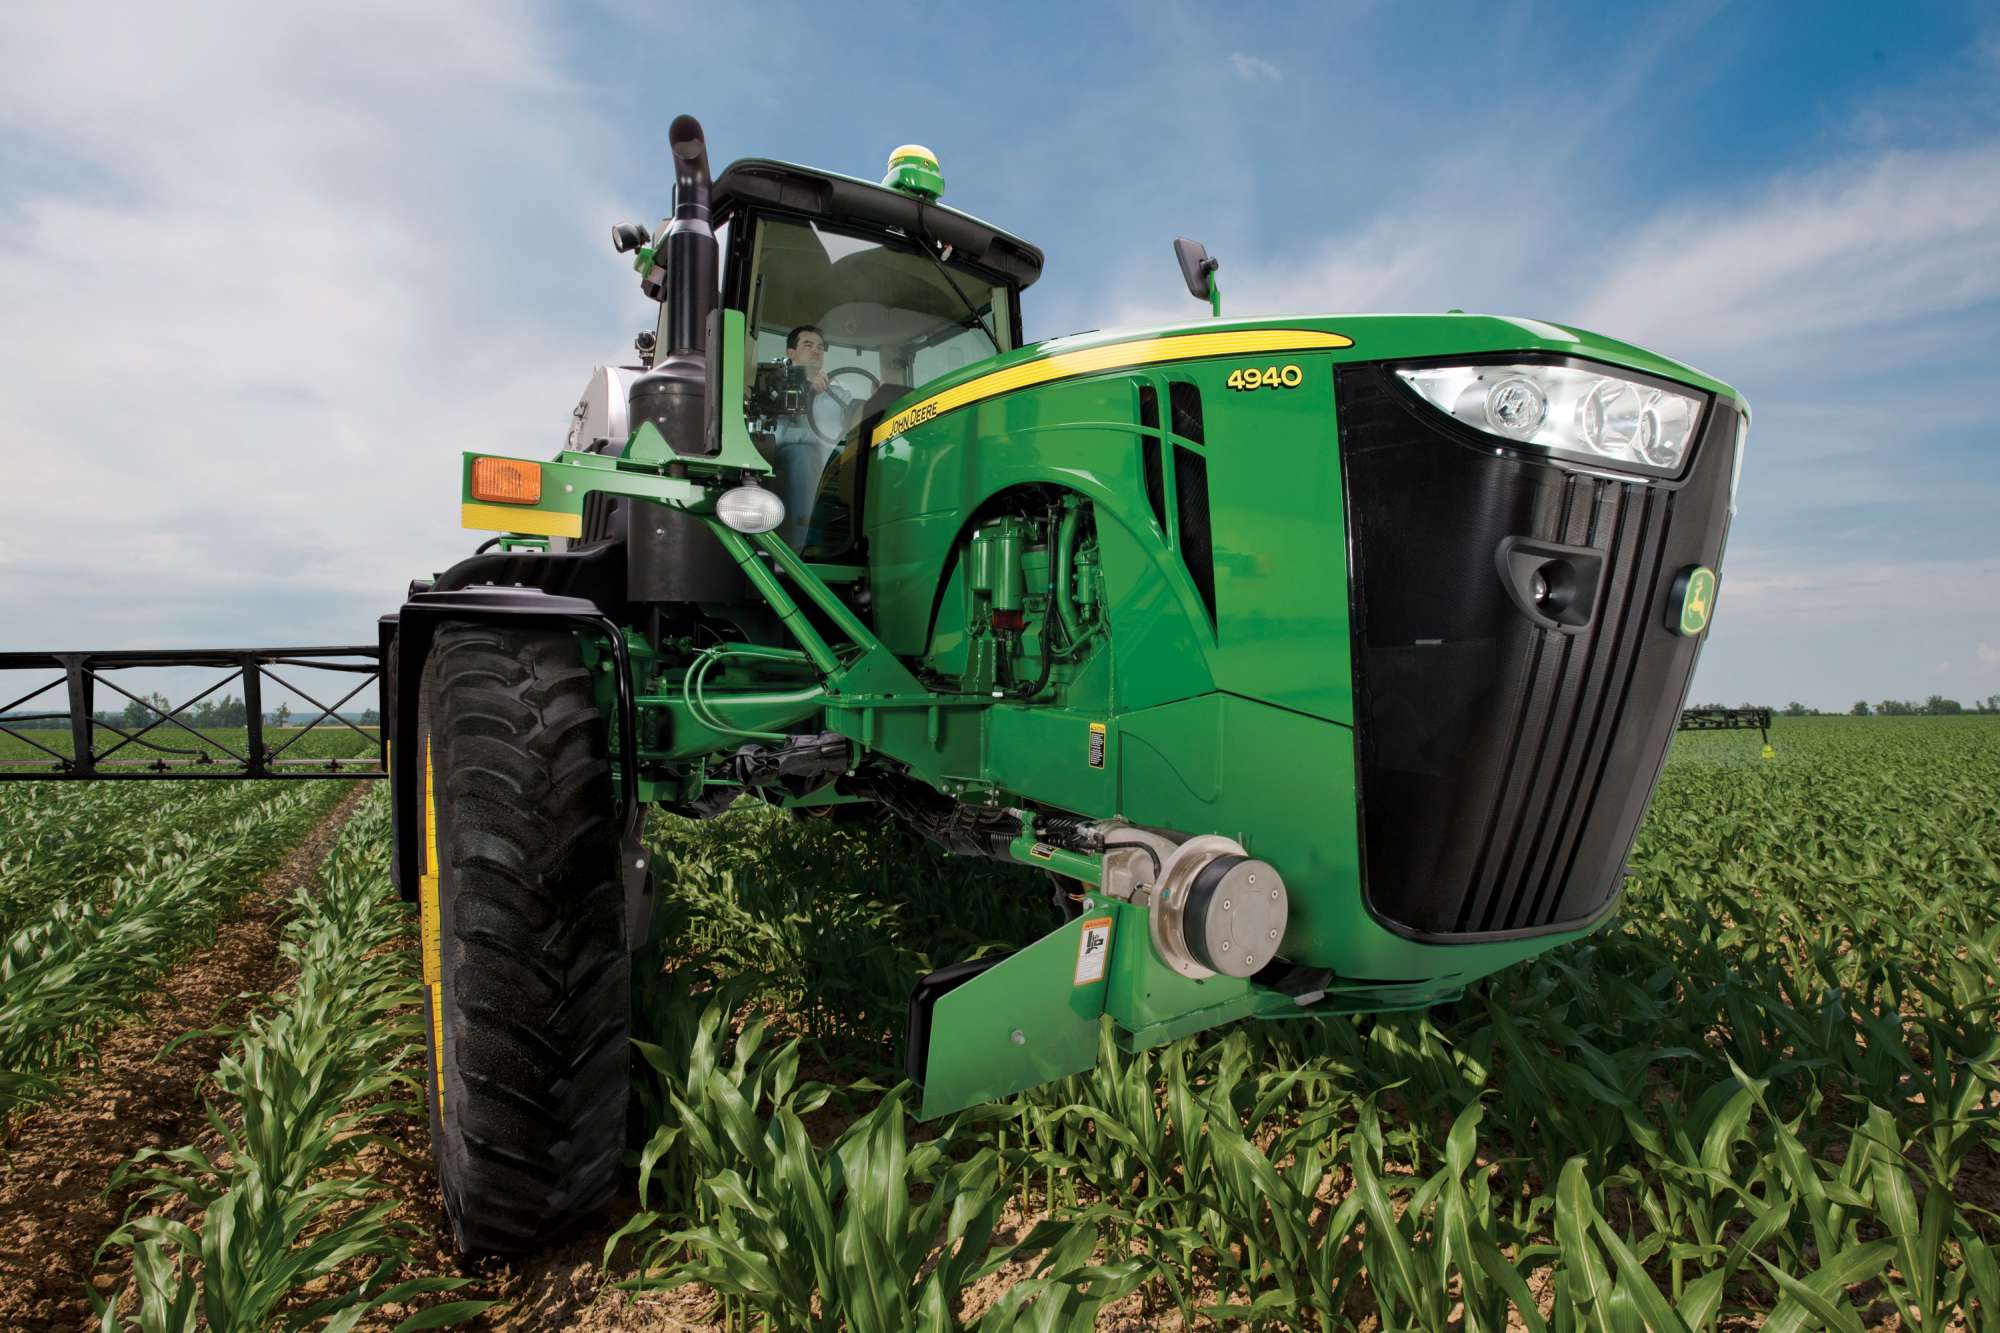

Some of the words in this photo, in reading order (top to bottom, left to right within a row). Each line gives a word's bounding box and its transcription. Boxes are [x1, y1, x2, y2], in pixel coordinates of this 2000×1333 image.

[1226, 364, 1303, 391] 4940
[889, 416, 910, 437] JOHN
[909, 402, 938, 426] DEERE
